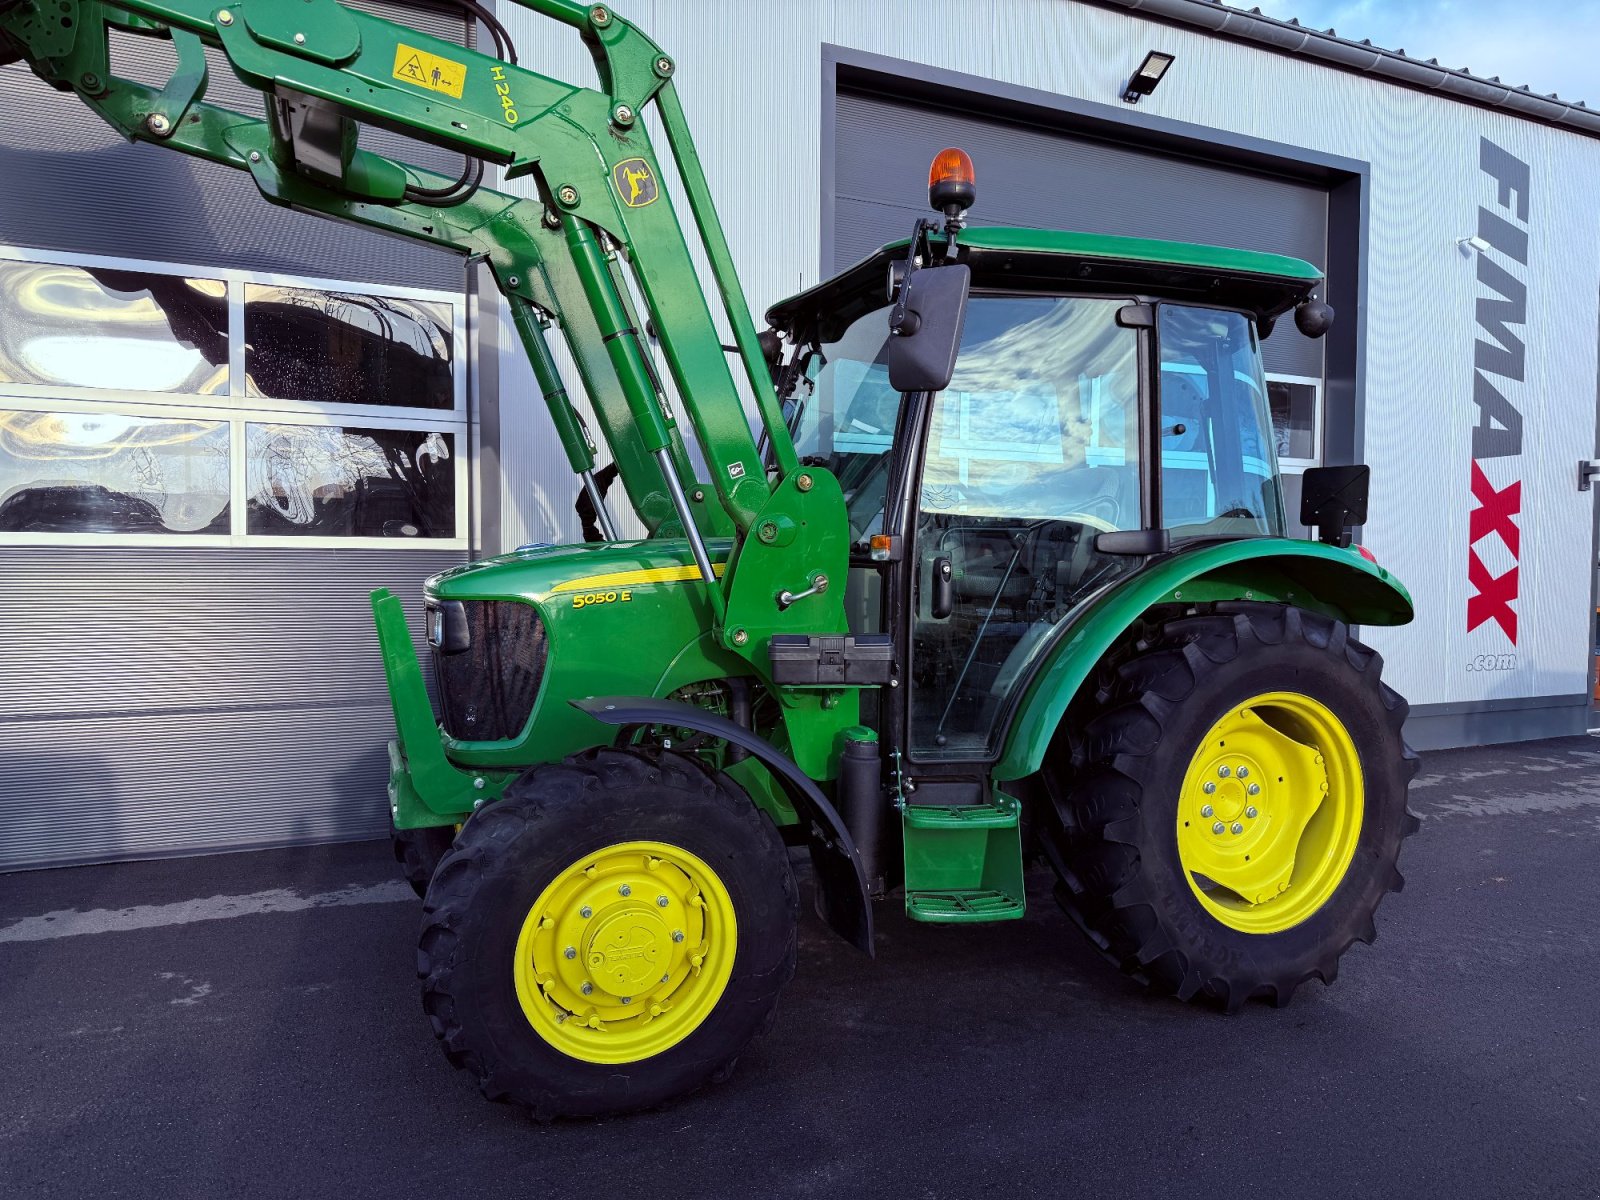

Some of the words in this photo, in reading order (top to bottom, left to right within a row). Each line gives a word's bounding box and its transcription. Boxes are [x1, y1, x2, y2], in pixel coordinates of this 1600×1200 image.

[1467, 136, 1530, 648] FIMAXX
[573, 591, 617, 609] 5050
[621, 589, 633, 602] E
[1466, 653, 1516, 672] .com
